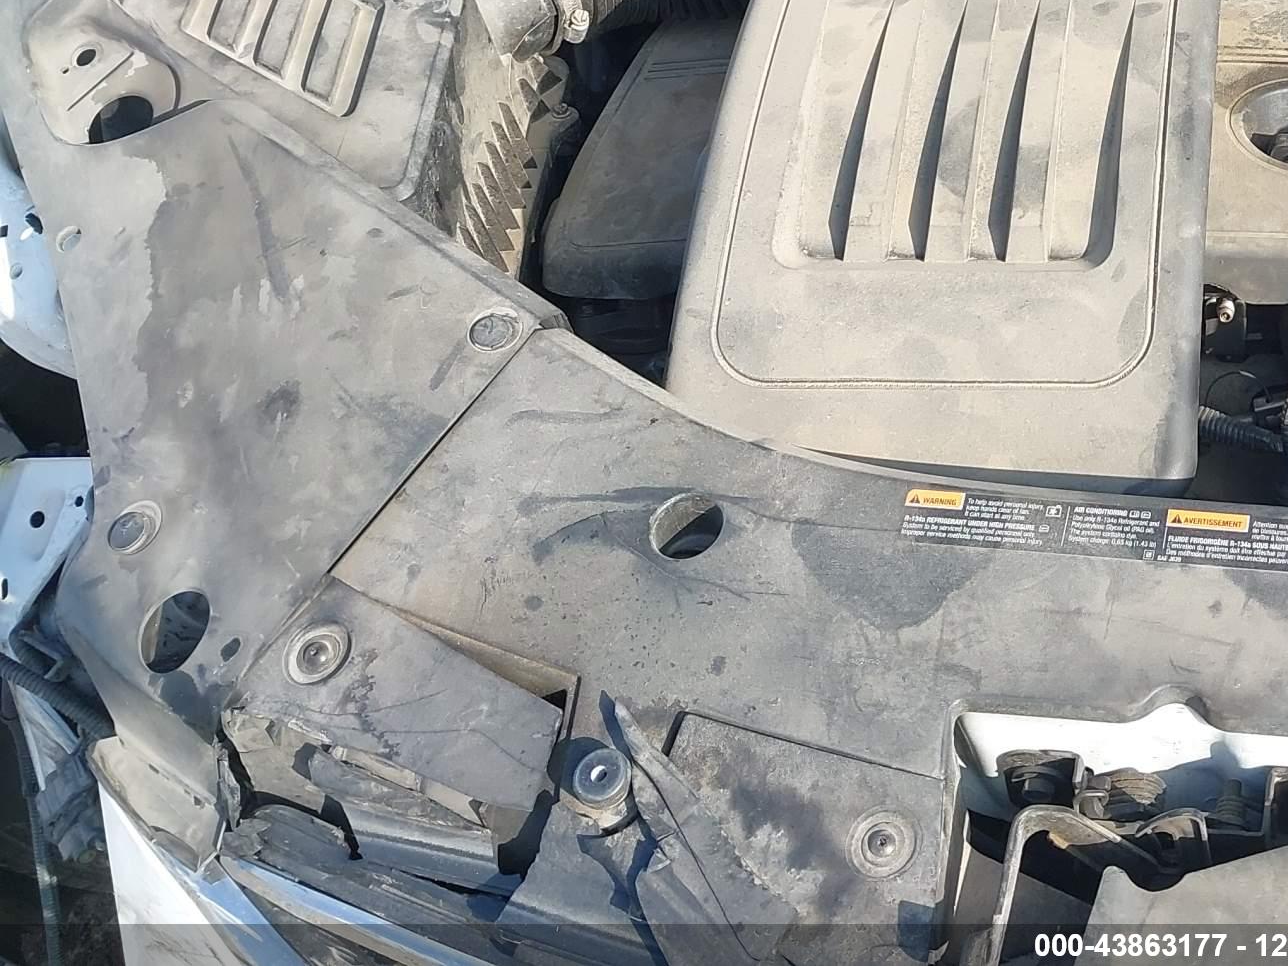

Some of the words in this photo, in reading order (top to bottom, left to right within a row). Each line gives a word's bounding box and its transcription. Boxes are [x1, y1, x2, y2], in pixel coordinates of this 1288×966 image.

[924, 497, 957, 506] WARNING
[1003, 501, 1027, 509] personal
[1086, 507, 1128, 517] CONDITIONING
[904, 515, 926, 523] R-134a
[926, 517, 968, 526] REFRIGERANT
[968, 520, 989, 528] UNDER
[1004, 523, 1035, 532] PRESSURE
[1118, 518, 1149, 527] Refrigerant
[1184, 517, 1242, 528] AVERTISSEMENT
[902, 522, 924, 530] System
[939, 525, 962, 533] serviced
[970, 528, 995, 536] qualified
[995, 530, 1023, 538] personnel
[1002, 537, 1027, 545] personal
[1068, 535, 1090, 543] System
[1168, 535, 1190, 543] FLUIDE
[1190, 537, 1230, 546] FRIGORIGÈNE
[1230, 540, 1252, 548] R-134a
[1252, 542, 1269, 550] SOUS
[1236, 555, 1268, 563] incorrectes
